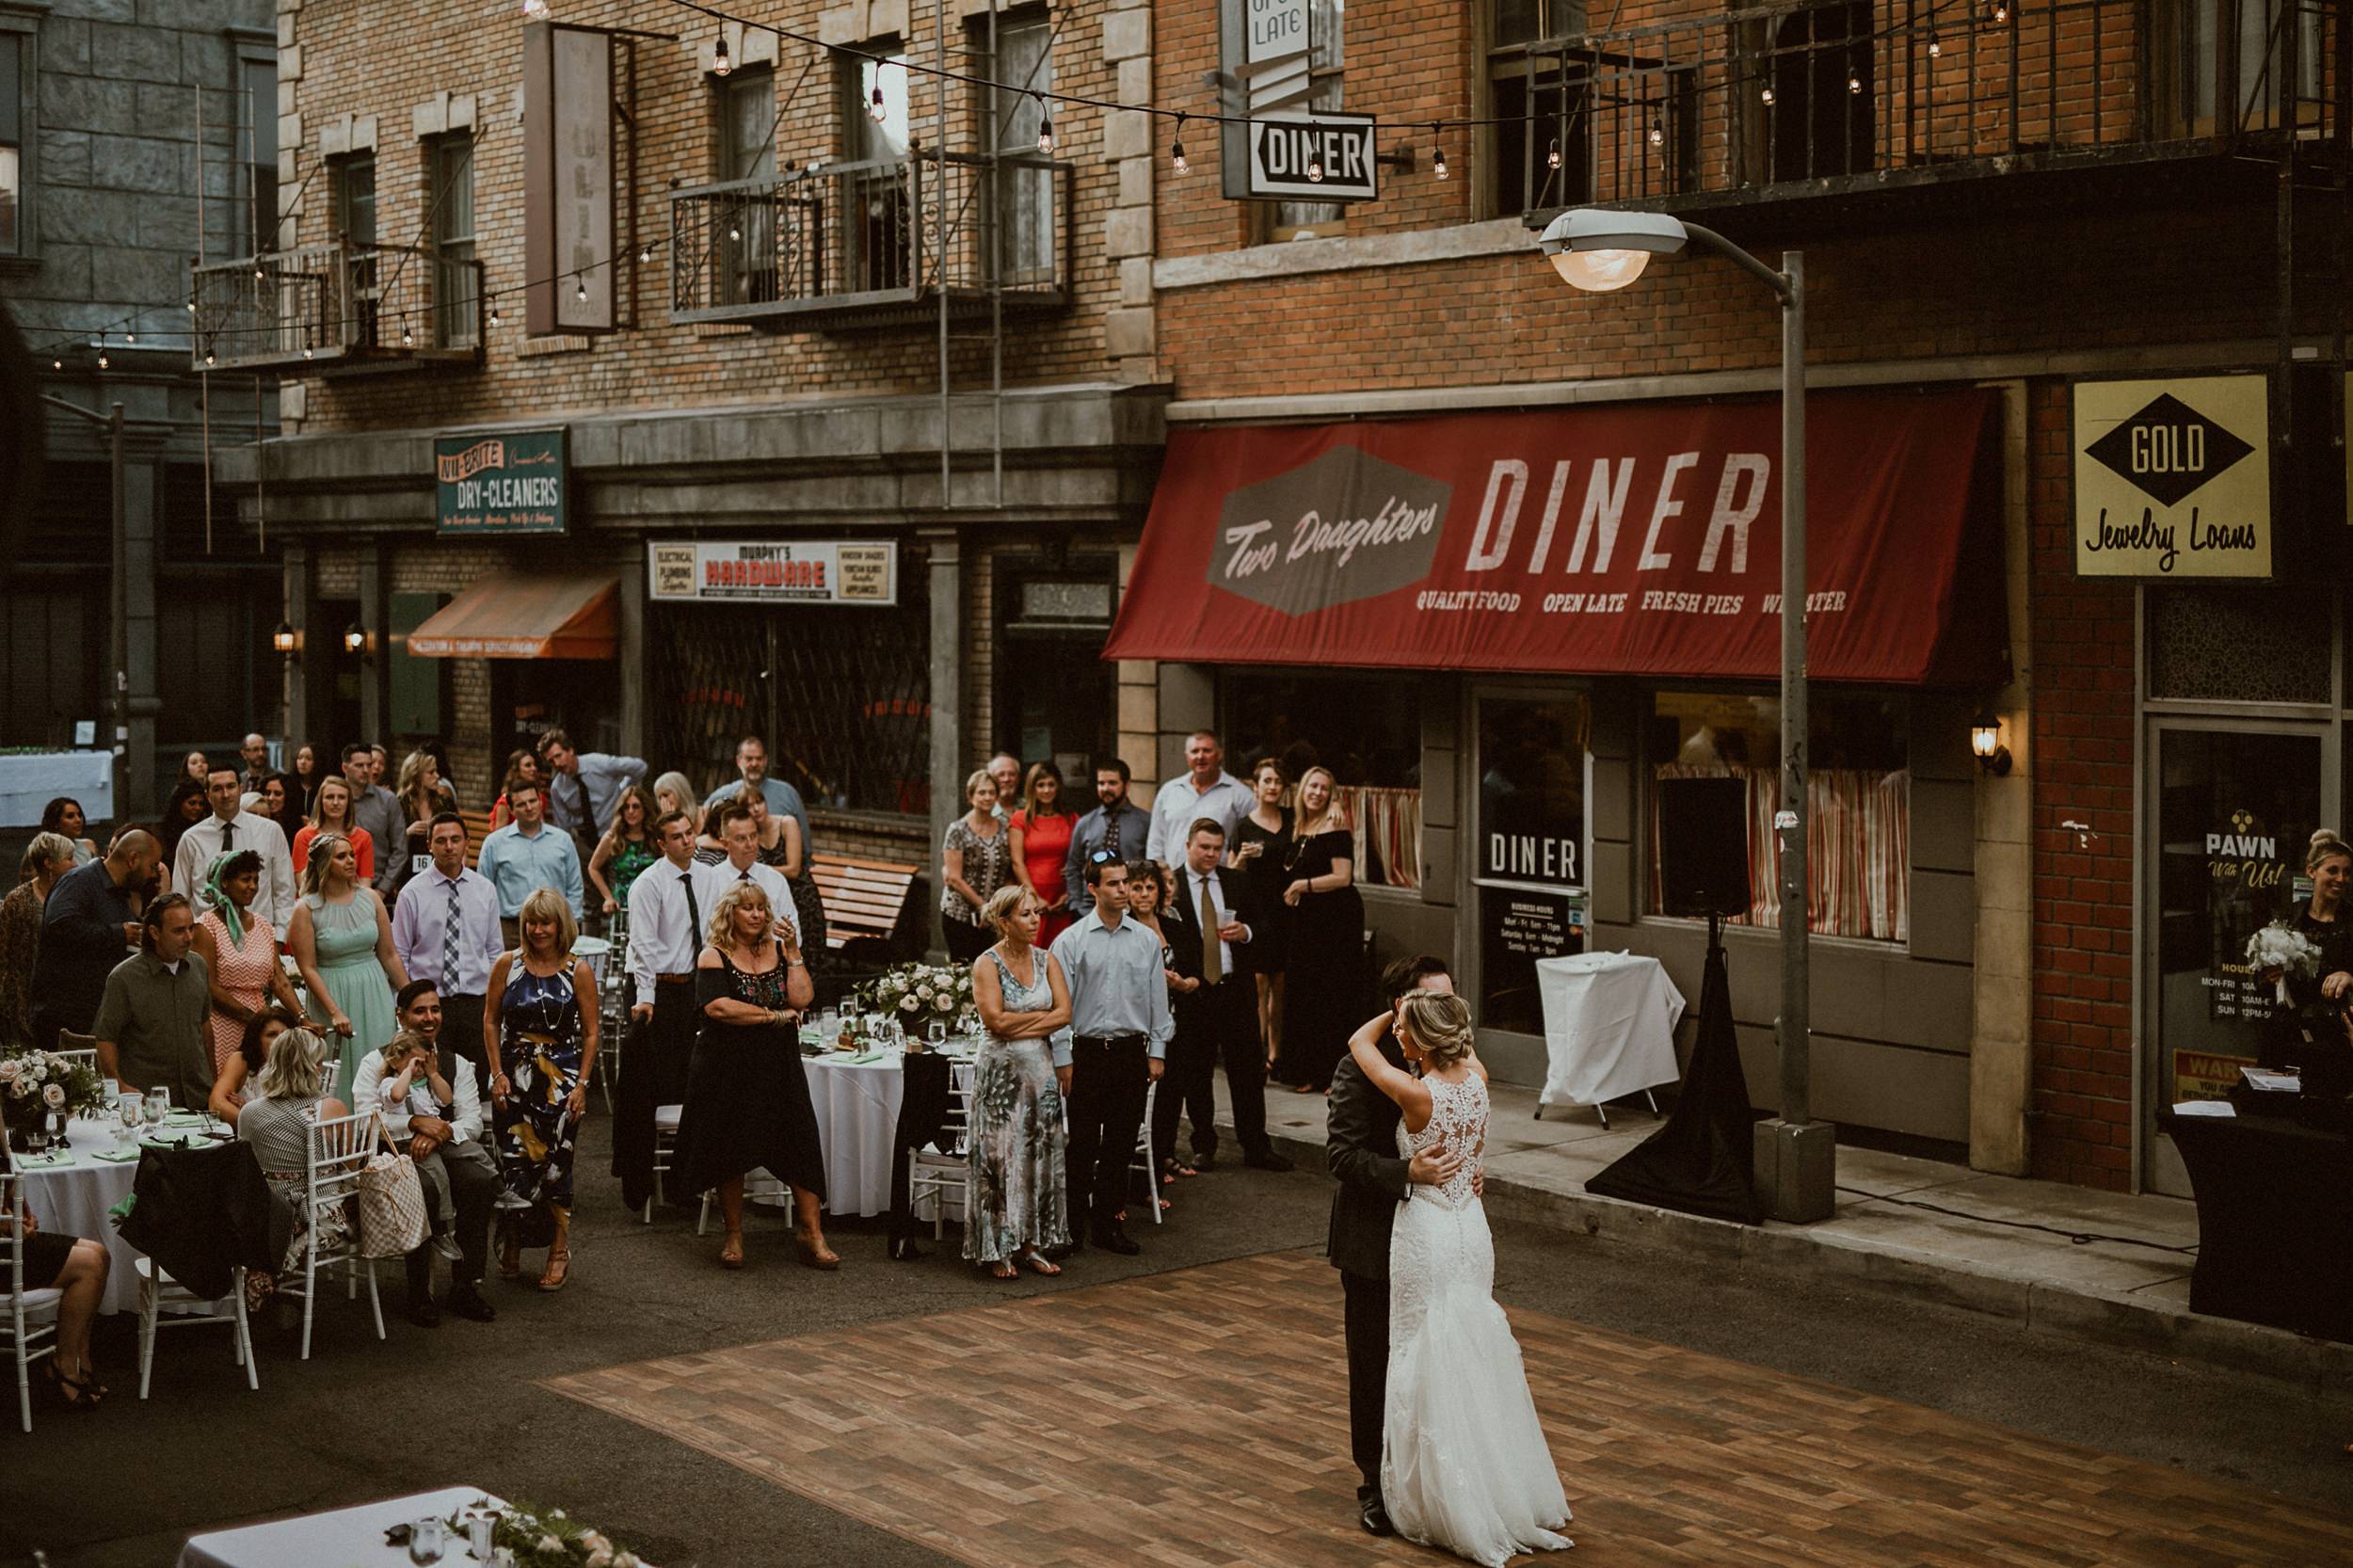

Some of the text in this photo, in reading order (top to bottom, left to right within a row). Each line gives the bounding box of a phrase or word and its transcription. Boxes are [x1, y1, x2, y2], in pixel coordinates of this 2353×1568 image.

[1255, 8, 1302, 45] LATE
[1268, 128, 1362, 178] DINER
[440, 442, 500, 478] NU-BRITE
[2132, 424, 2204, 473] GOLD
[457, 477, 558, 509] DRY-CLEANERS
[1465, 452, 1770, 574] DINER
[1225, 495, 1438, 579] Two Daughters
[2086, 506, 2256, 573] Jewelry Loans
[739, 546, 791, 560] MURPHY'S
[706, 560, 826, 587] HARDWARE
[1417, 590, 1521, 612] QUALITY FOOD
[1543, 593, 1627, 614] OPEN LATE
[1641, 591, 1744, 615] FRESH PIES
[1491, 833, 1576, 879] DINER
[2206, 833, 2276, 859] PAWN
[417, 857, 428, 870] 16
[2207, 860, 2285, 888] With Us!
[2201, 977, 2235, 988] MON-FRI
[2217, 1004, 2235, 1015] SUN
[2219, 992, 2235, 1002] SAT
